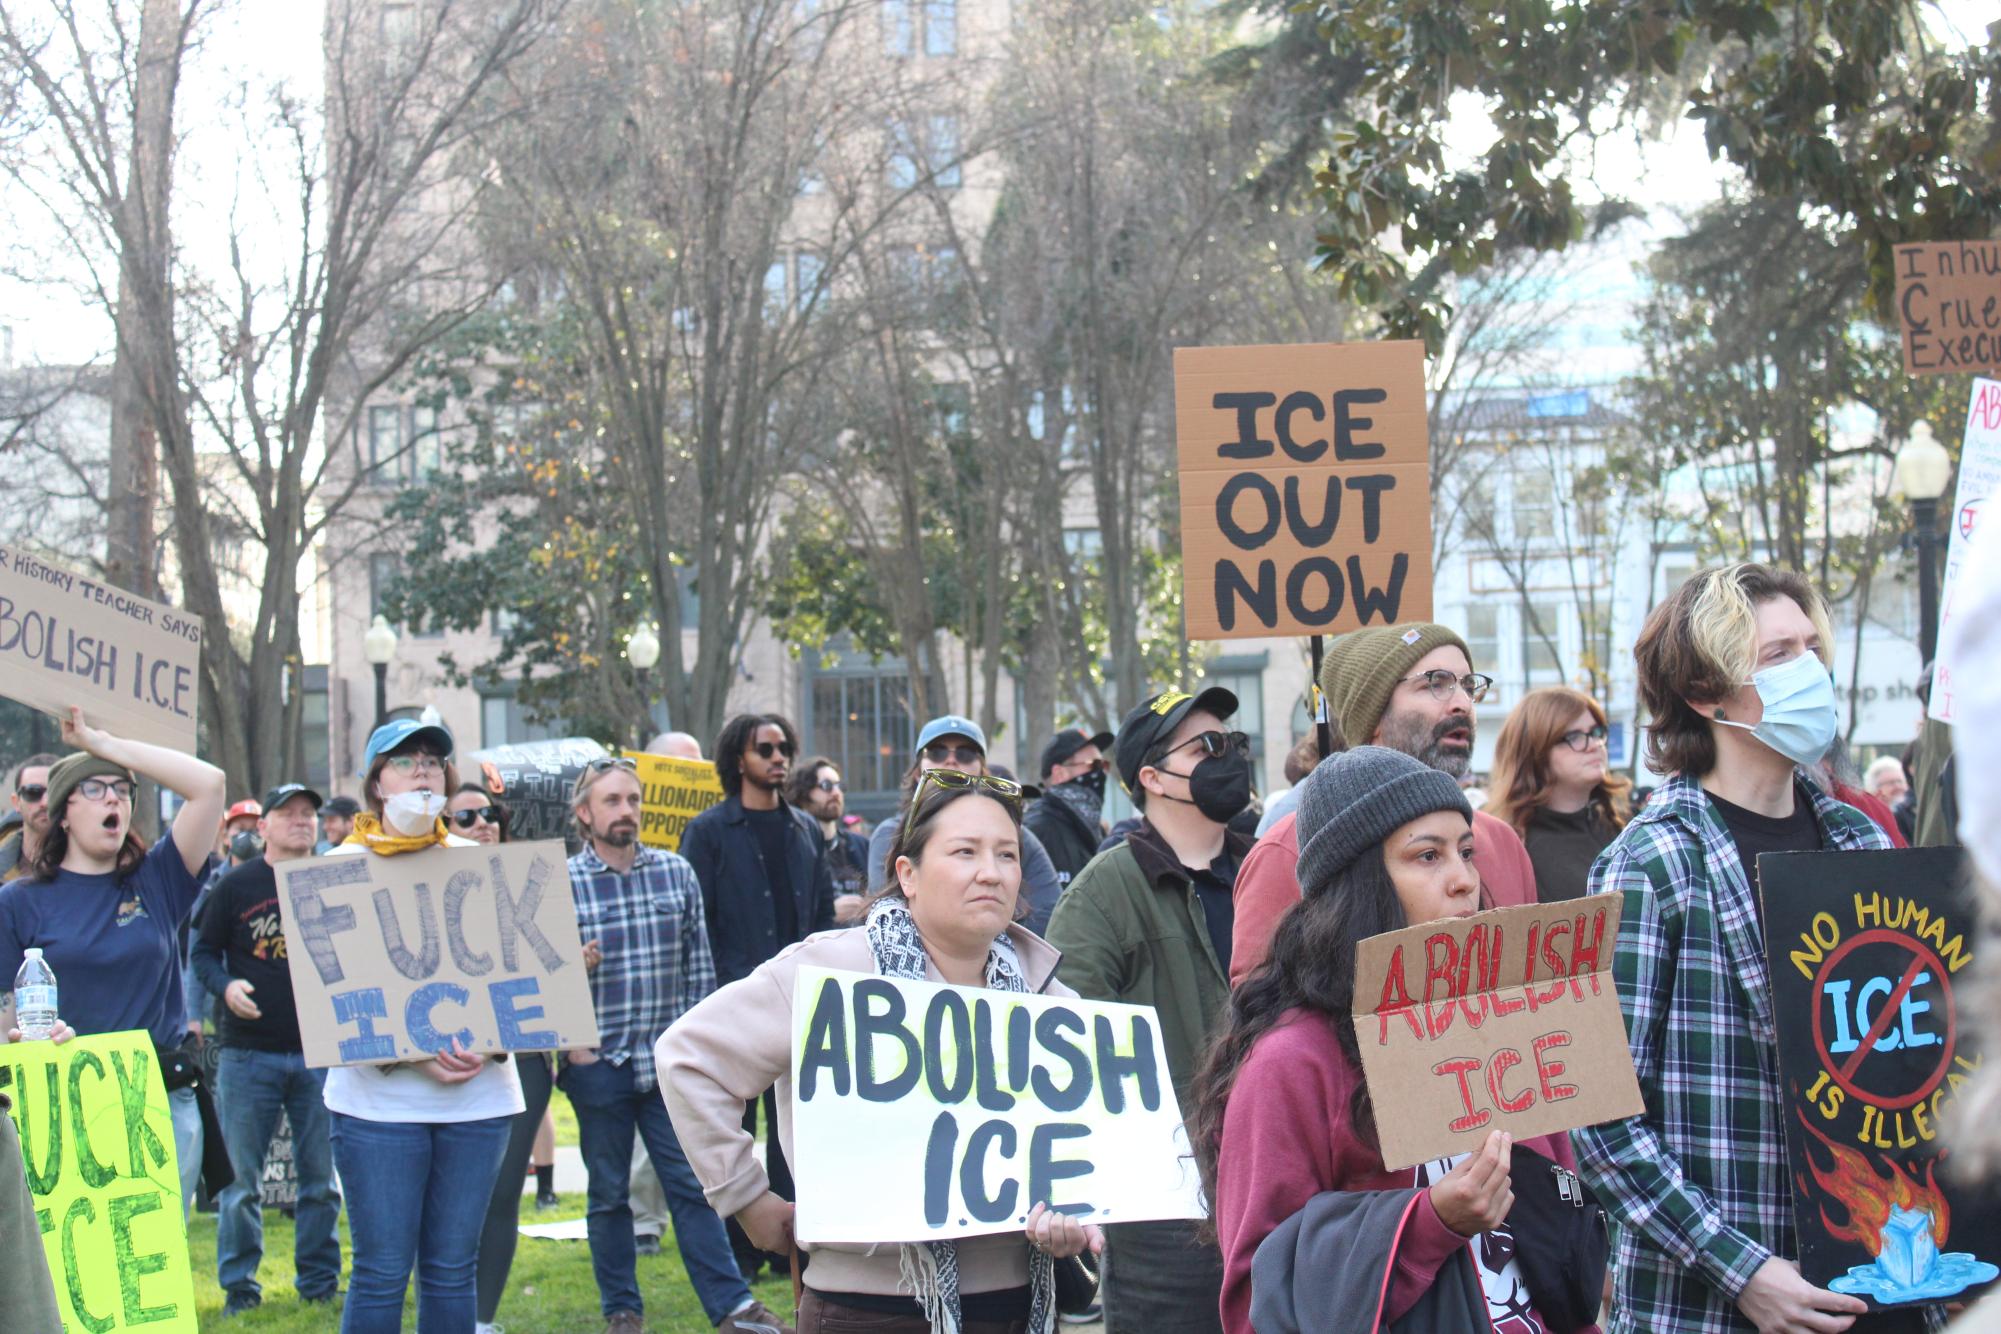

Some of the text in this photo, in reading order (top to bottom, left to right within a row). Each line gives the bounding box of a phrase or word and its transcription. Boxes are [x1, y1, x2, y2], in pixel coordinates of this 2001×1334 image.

[1213, 388, 1388, 463] ICE
[1215, 472, 1397, 551] OUT
[80, 580, 153, 625] TEACHER
[160, 614, 199, 643] SAYS
[1215, 553, 1409, 631] NOW
[285, 853, 570, 986] FUCK
[1790, 891, 1973, 980] NO HUMAN
[331, 976, 568, 1063] I.C.E.
[1373, 907, 1607, 1046] ABOLISH
[798, 977, 1161, 1115] ABOLISH
[1431, 1031, 1580, 1133] ICE
[1805, 1070, 1846, 1120] IS
[924, 1110, 1111, 1229] I.C.E.
[36, 1190, 178, 1334] CE
